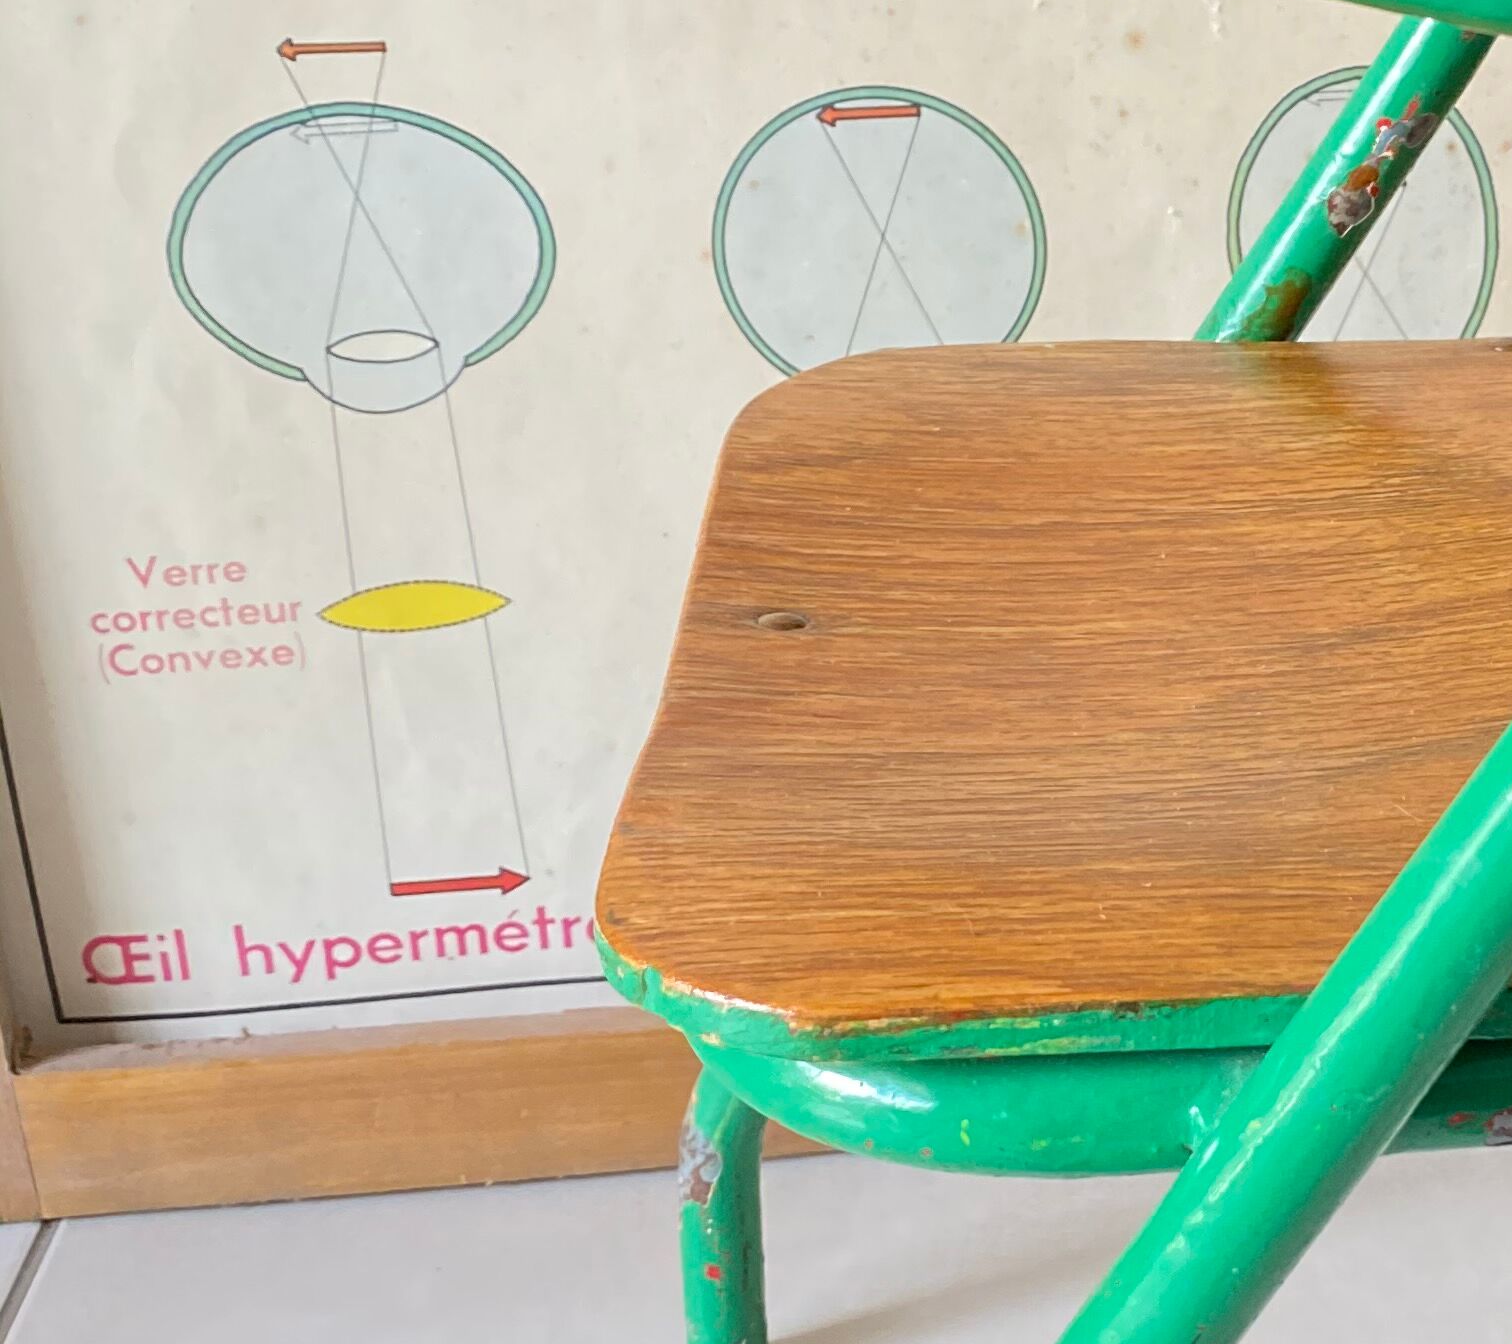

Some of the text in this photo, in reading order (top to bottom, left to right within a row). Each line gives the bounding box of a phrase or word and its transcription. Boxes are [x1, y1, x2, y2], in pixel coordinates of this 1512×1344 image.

[124, 554, 250, 590] Verre
[88, 596, 304, 636] correcteur
[98, 632, 308, 685] (Convexe)
[81, 904, 596, 986] Œil hypermétr
